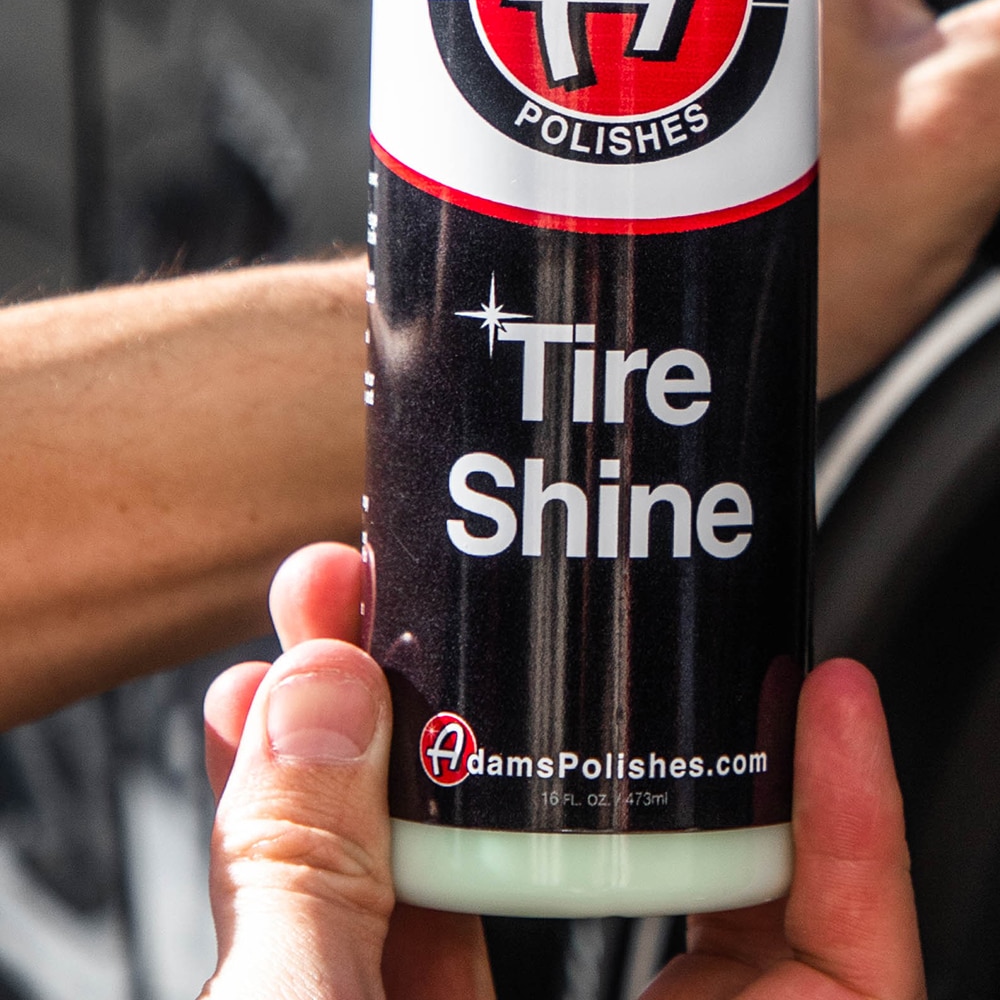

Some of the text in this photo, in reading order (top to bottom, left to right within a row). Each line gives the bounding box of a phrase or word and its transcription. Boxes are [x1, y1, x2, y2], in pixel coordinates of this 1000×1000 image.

[514, 100, 710, 157] POLISHES
[497, 322, 712, 427] Tire
[446, 452, 753, 559] Shine
[541, 790, 560, 806] 16
[563, 793, 582, 807] FL.
[587, 793, 611, 807] OZ.
[626, 791, 668, 806] 473ml
